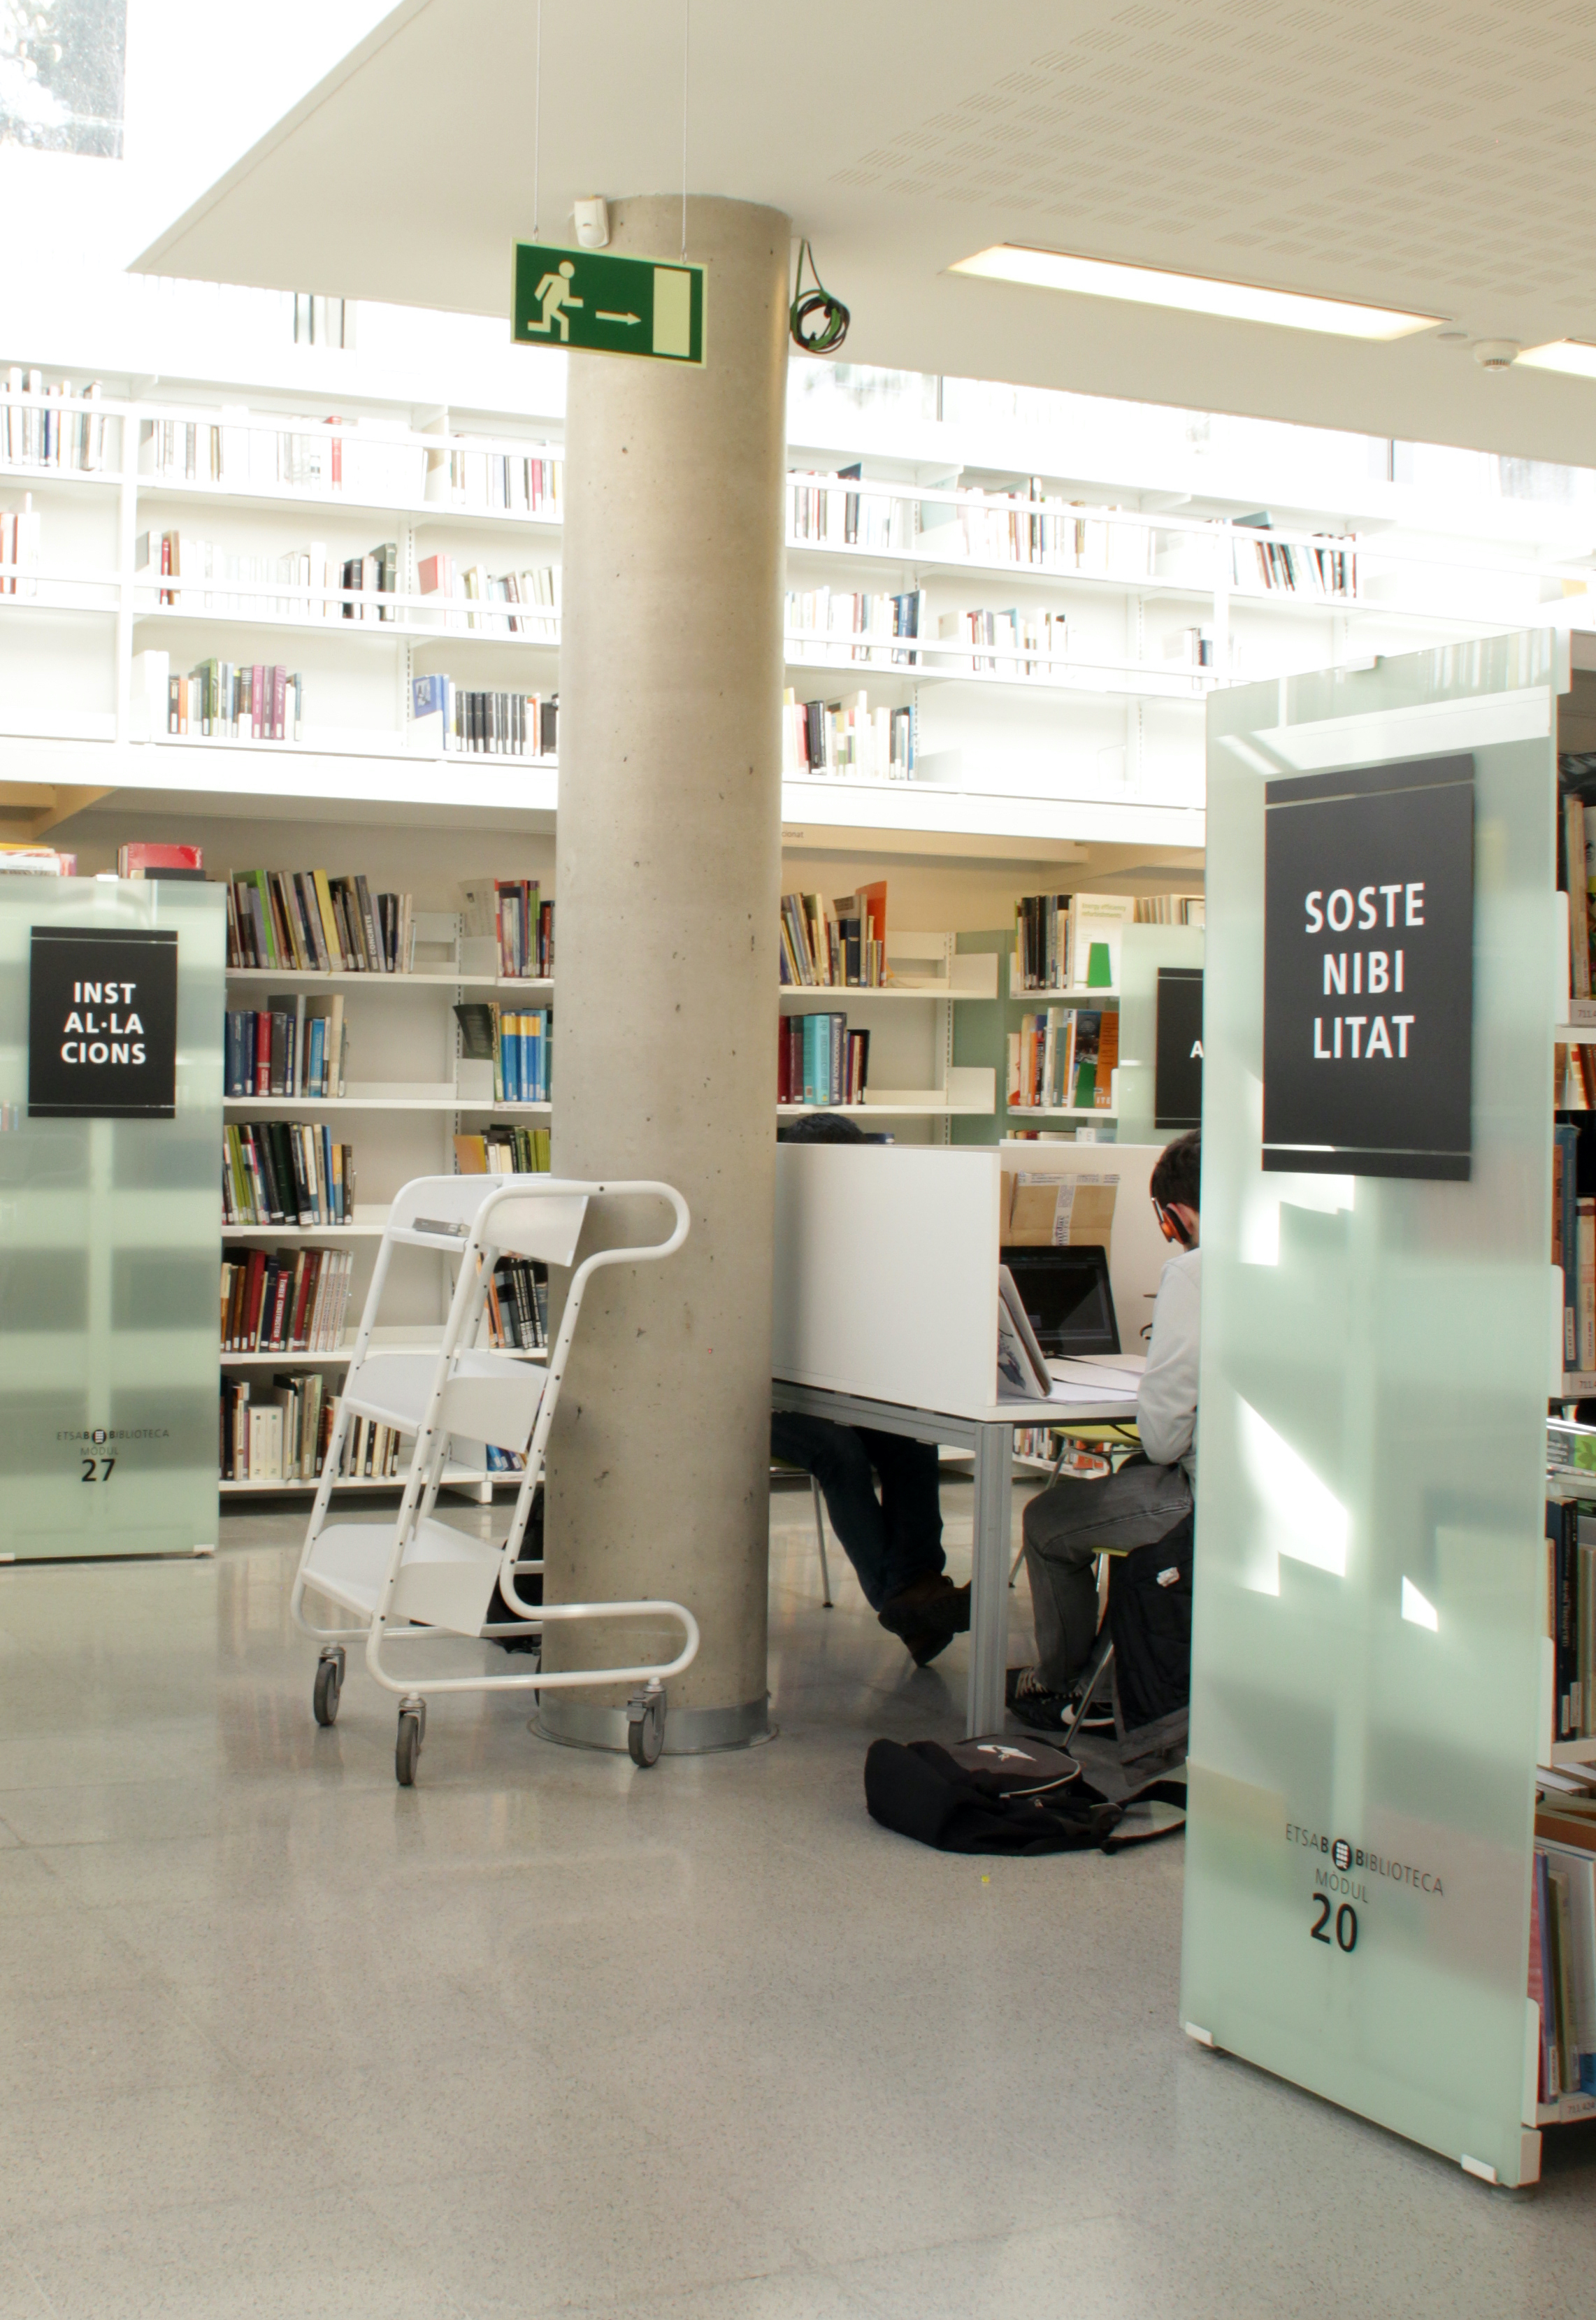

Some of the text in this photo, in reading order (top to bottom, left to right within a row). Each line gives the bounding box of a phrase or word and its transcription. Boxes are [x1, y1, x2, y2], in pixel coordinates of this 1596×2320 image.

[1305, 882, 1425, 933] SOSTE
[364, 914, 377, 955] CONCRETE
[1323, 950, 1404, 995] NIBI
[73, 982, 136, 1004] INST
[63, 1012, 144, 1034] AL·LA
[1314, 1015, 1415, 1059] LITAT
[60, 1042, 146, 1064] CIONS
[57, 1429, 169, 1440] ETSAB BIBLIOTECA
[81, 1458, 115, 1482] 27
[1285, 1823, 1444, 1896] ETSAB BIBLIOTECA
[1315, 1868, 1368, 1903] MÒDUL
[1310, 1892, 1358, 1952] 20
